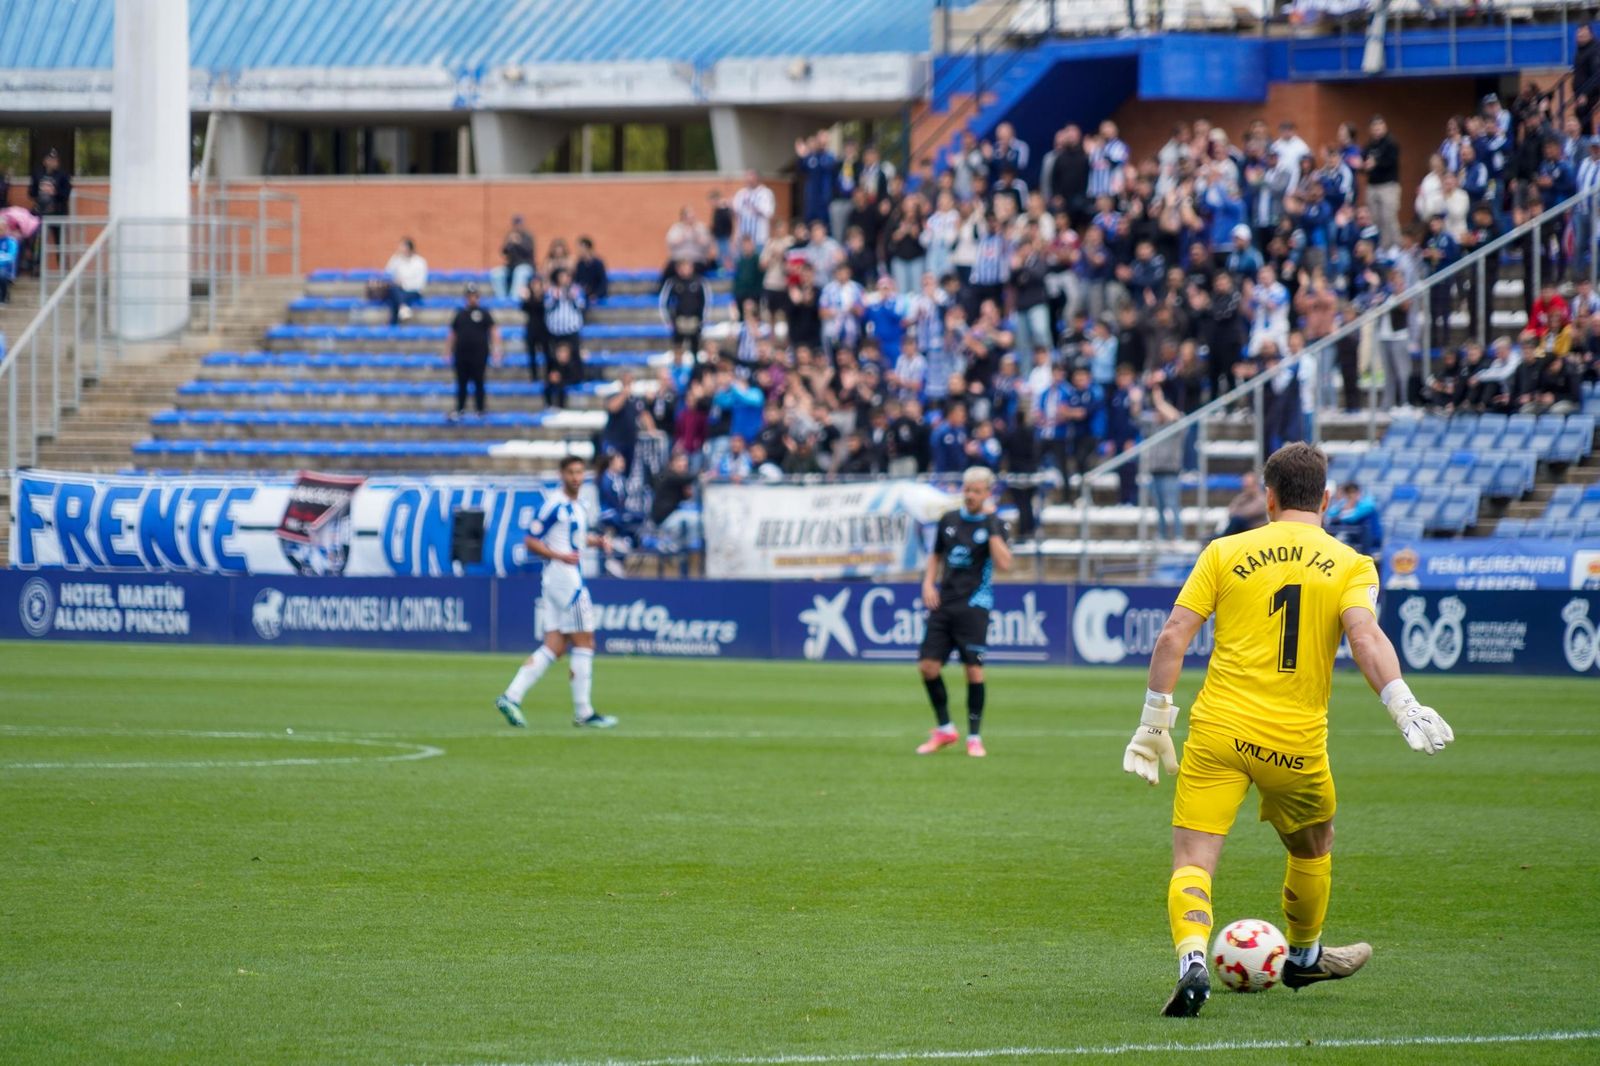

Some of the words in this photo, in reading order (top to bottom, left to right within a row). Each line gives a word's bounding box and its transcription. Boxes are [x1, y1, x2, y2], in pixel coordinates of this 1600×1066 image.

[18, 478, 258, 575] FRENTE
[60, 582, 116, 607] HOTEL
[118, 580, 185, 610] MARTÍN
[54, 606, 123, 632] ALONSO
[283, 595, 380, 631] ATRACCIONES
[380, 597, 400, 632] LA
[400, 596, 442, 631] CINTA
[1269, 584, 1301, 673] 1
[1234, 738, 1304, 770] VALANS
